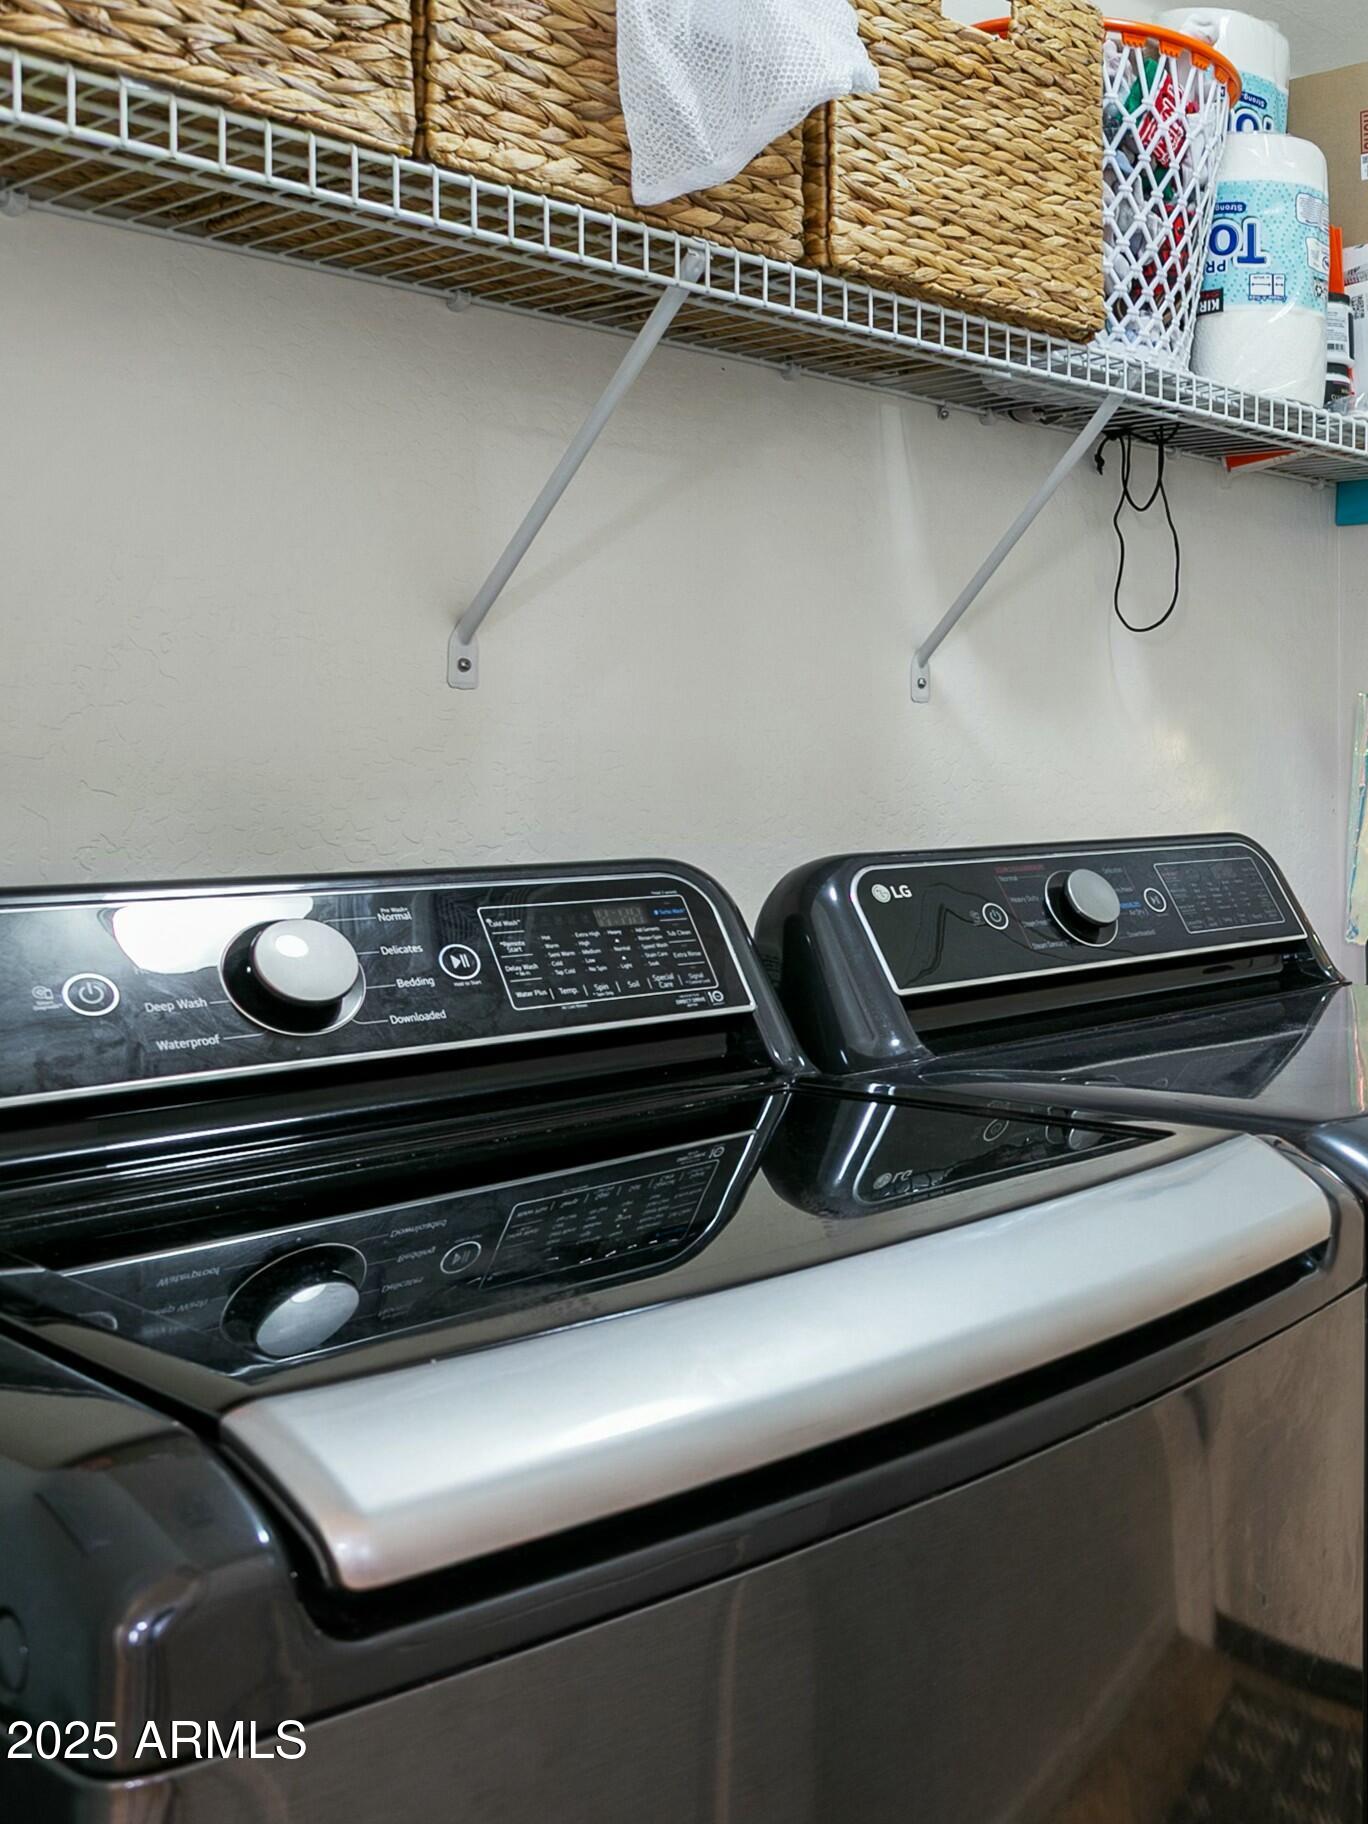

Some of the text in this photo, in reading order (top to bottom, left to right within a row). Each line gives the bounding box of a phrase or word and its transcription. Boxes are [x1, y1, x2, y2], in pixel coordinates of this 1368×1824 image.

[891, 884, 912, 900] LG
[377, 911, 412, 921] Normal
[380, 945, 423, 955] Delicates
[396, 977, 436, 988] Bedding
[651, 973, 674, 982] Special
[593, 983, 609, 992] Spin
[658, 981, 674, 989] Care
[144, 998, 208, 1013] Deep Wash
[389, 1009, 447, 1024] Downloaded
[156, 1034, 221, 1052] Waterproof
